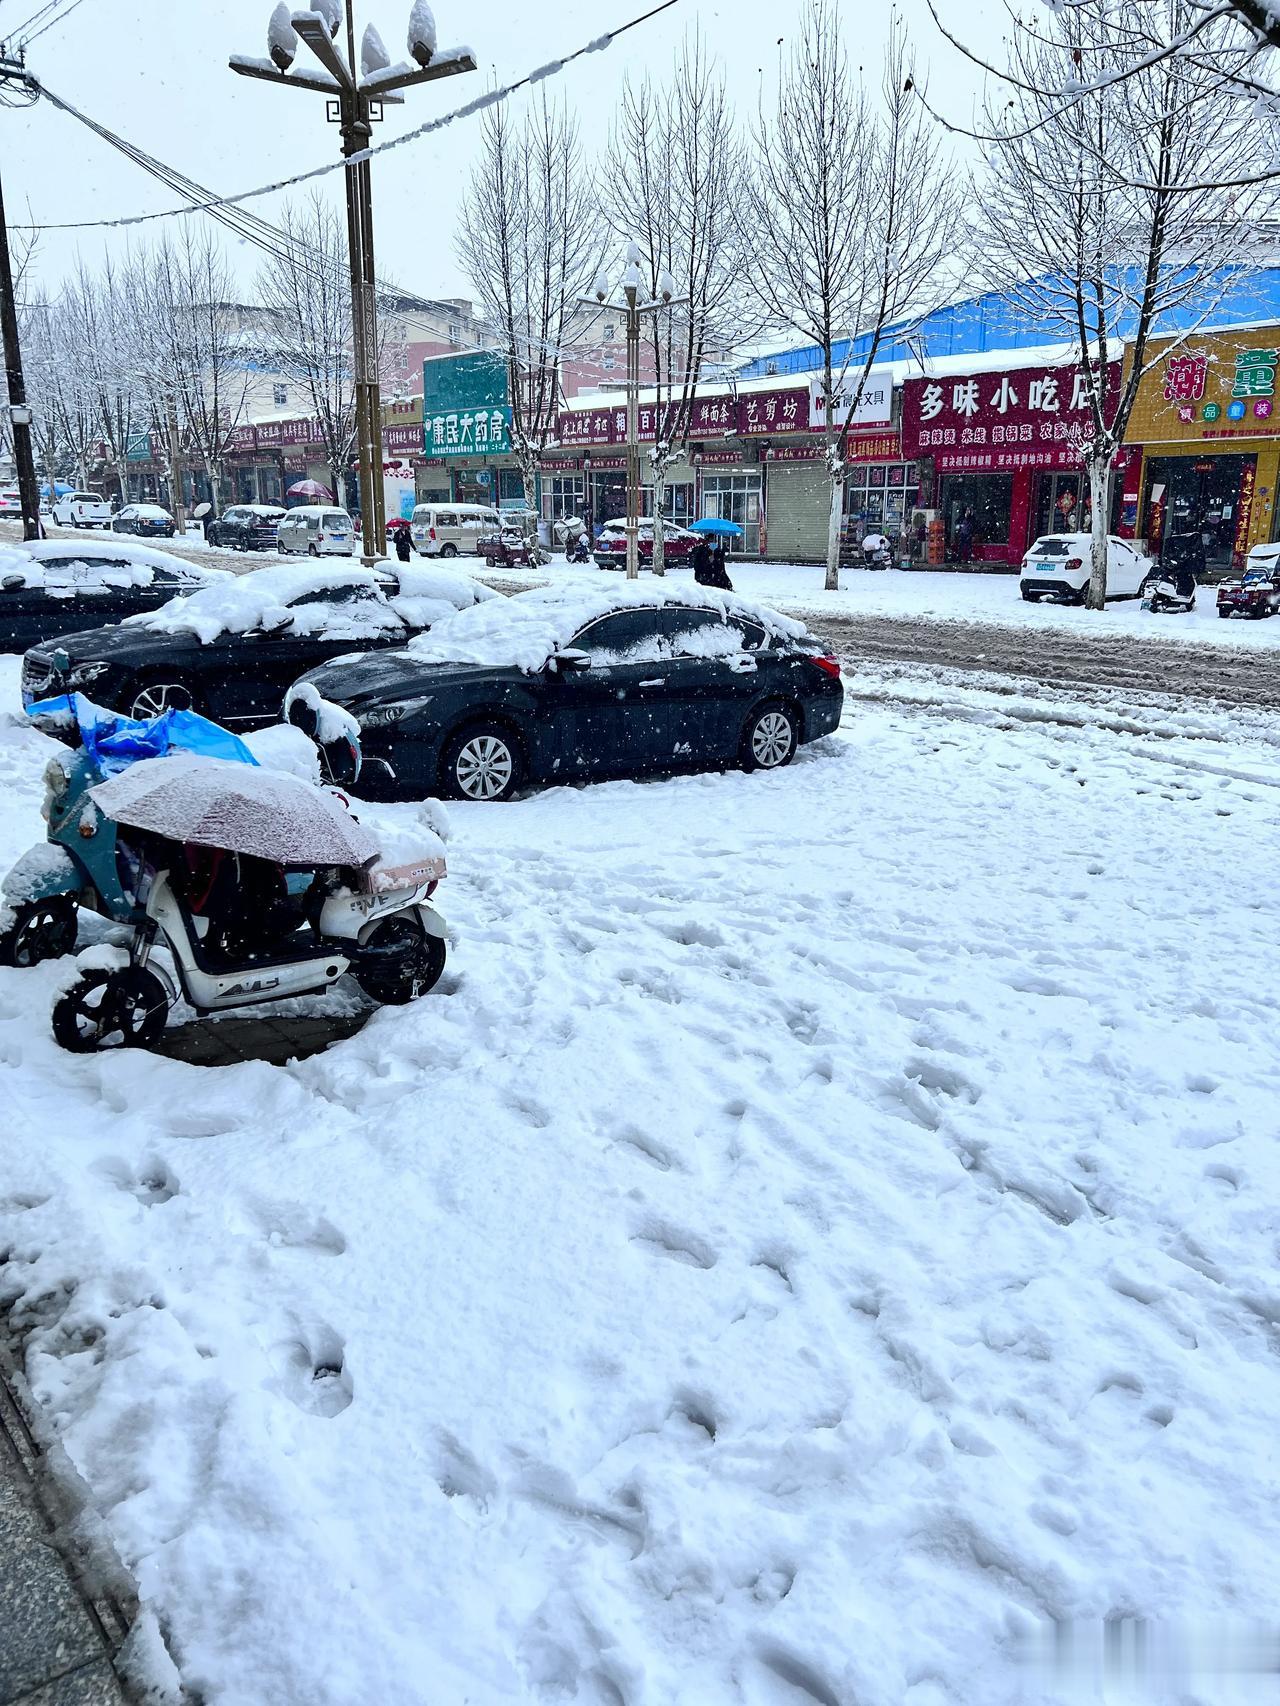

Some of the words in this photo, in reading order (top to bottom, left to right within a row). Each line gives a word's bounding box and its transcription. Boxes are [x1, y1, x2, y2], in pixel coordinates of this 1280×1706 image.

[919, 372, 1101, 421] 多味小吃店
[700, 403, 729, 424] 鲜面条
[746, 397, 798, 423] 艺剪坊
[432, 410, 504, 445] 康民大药房
[918, 428, 956, 446] 麻辣烫
[961, 426, 987, 445] 米线
[1040, 421, 1096, 440] 农家小炒
